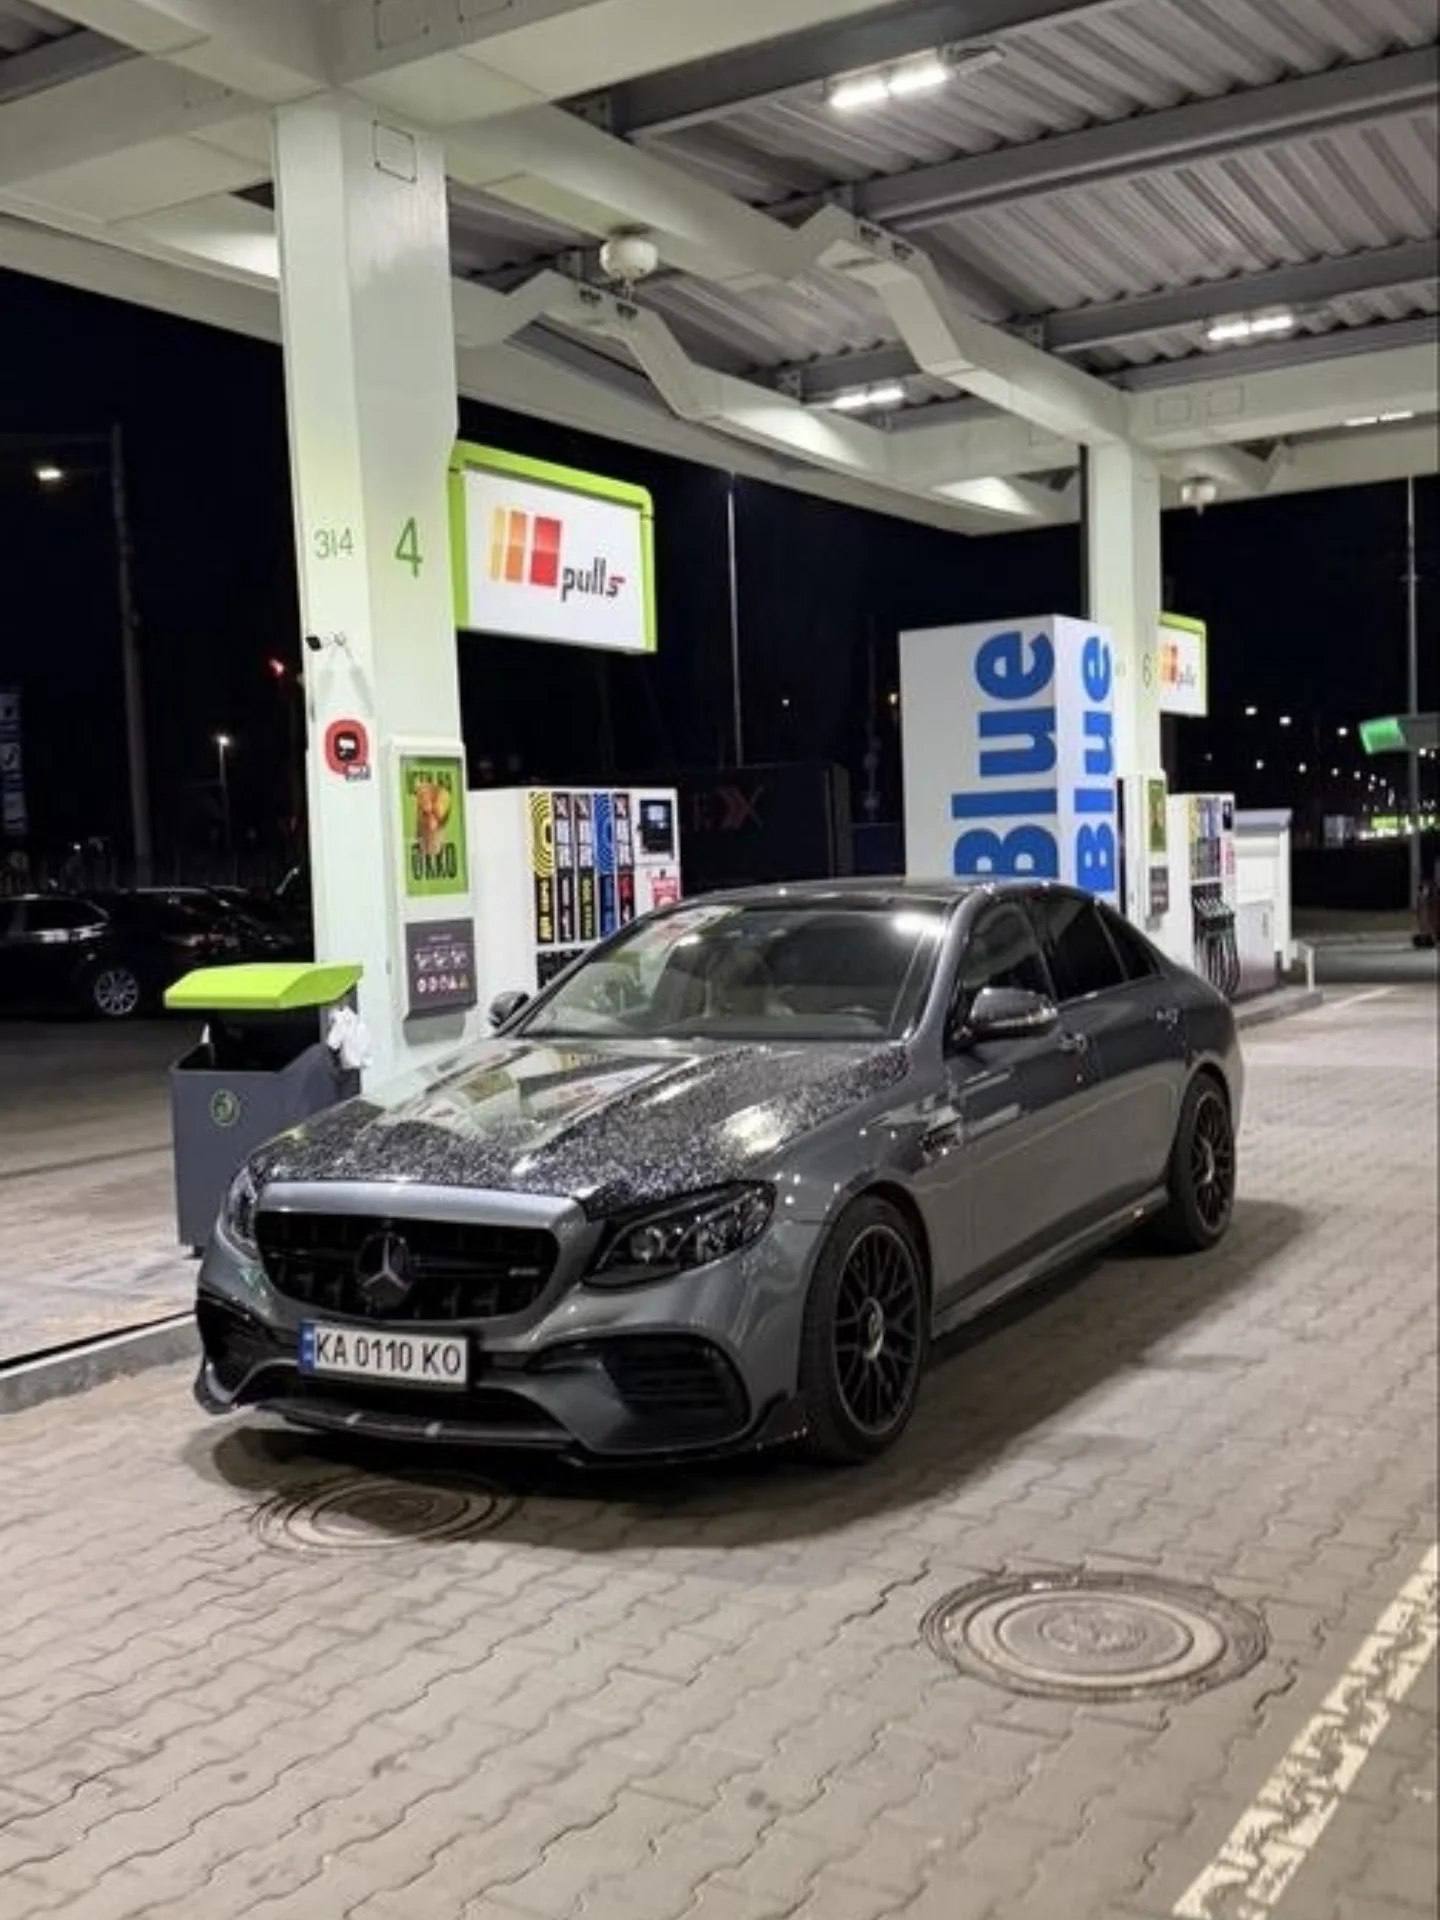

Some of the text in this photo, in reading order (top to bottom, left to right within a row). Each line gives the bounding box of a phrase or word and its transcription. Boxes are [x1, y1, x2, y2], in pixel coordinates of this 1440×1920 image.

[395, 516, 422, 578] 4
[562, 558, 626, 602] pulls
[951, 631, 1058, 878] Blue
[1074, 636, 1114, 892] Blue
[315, 1334, 461, 1375] KA 0110 KO
